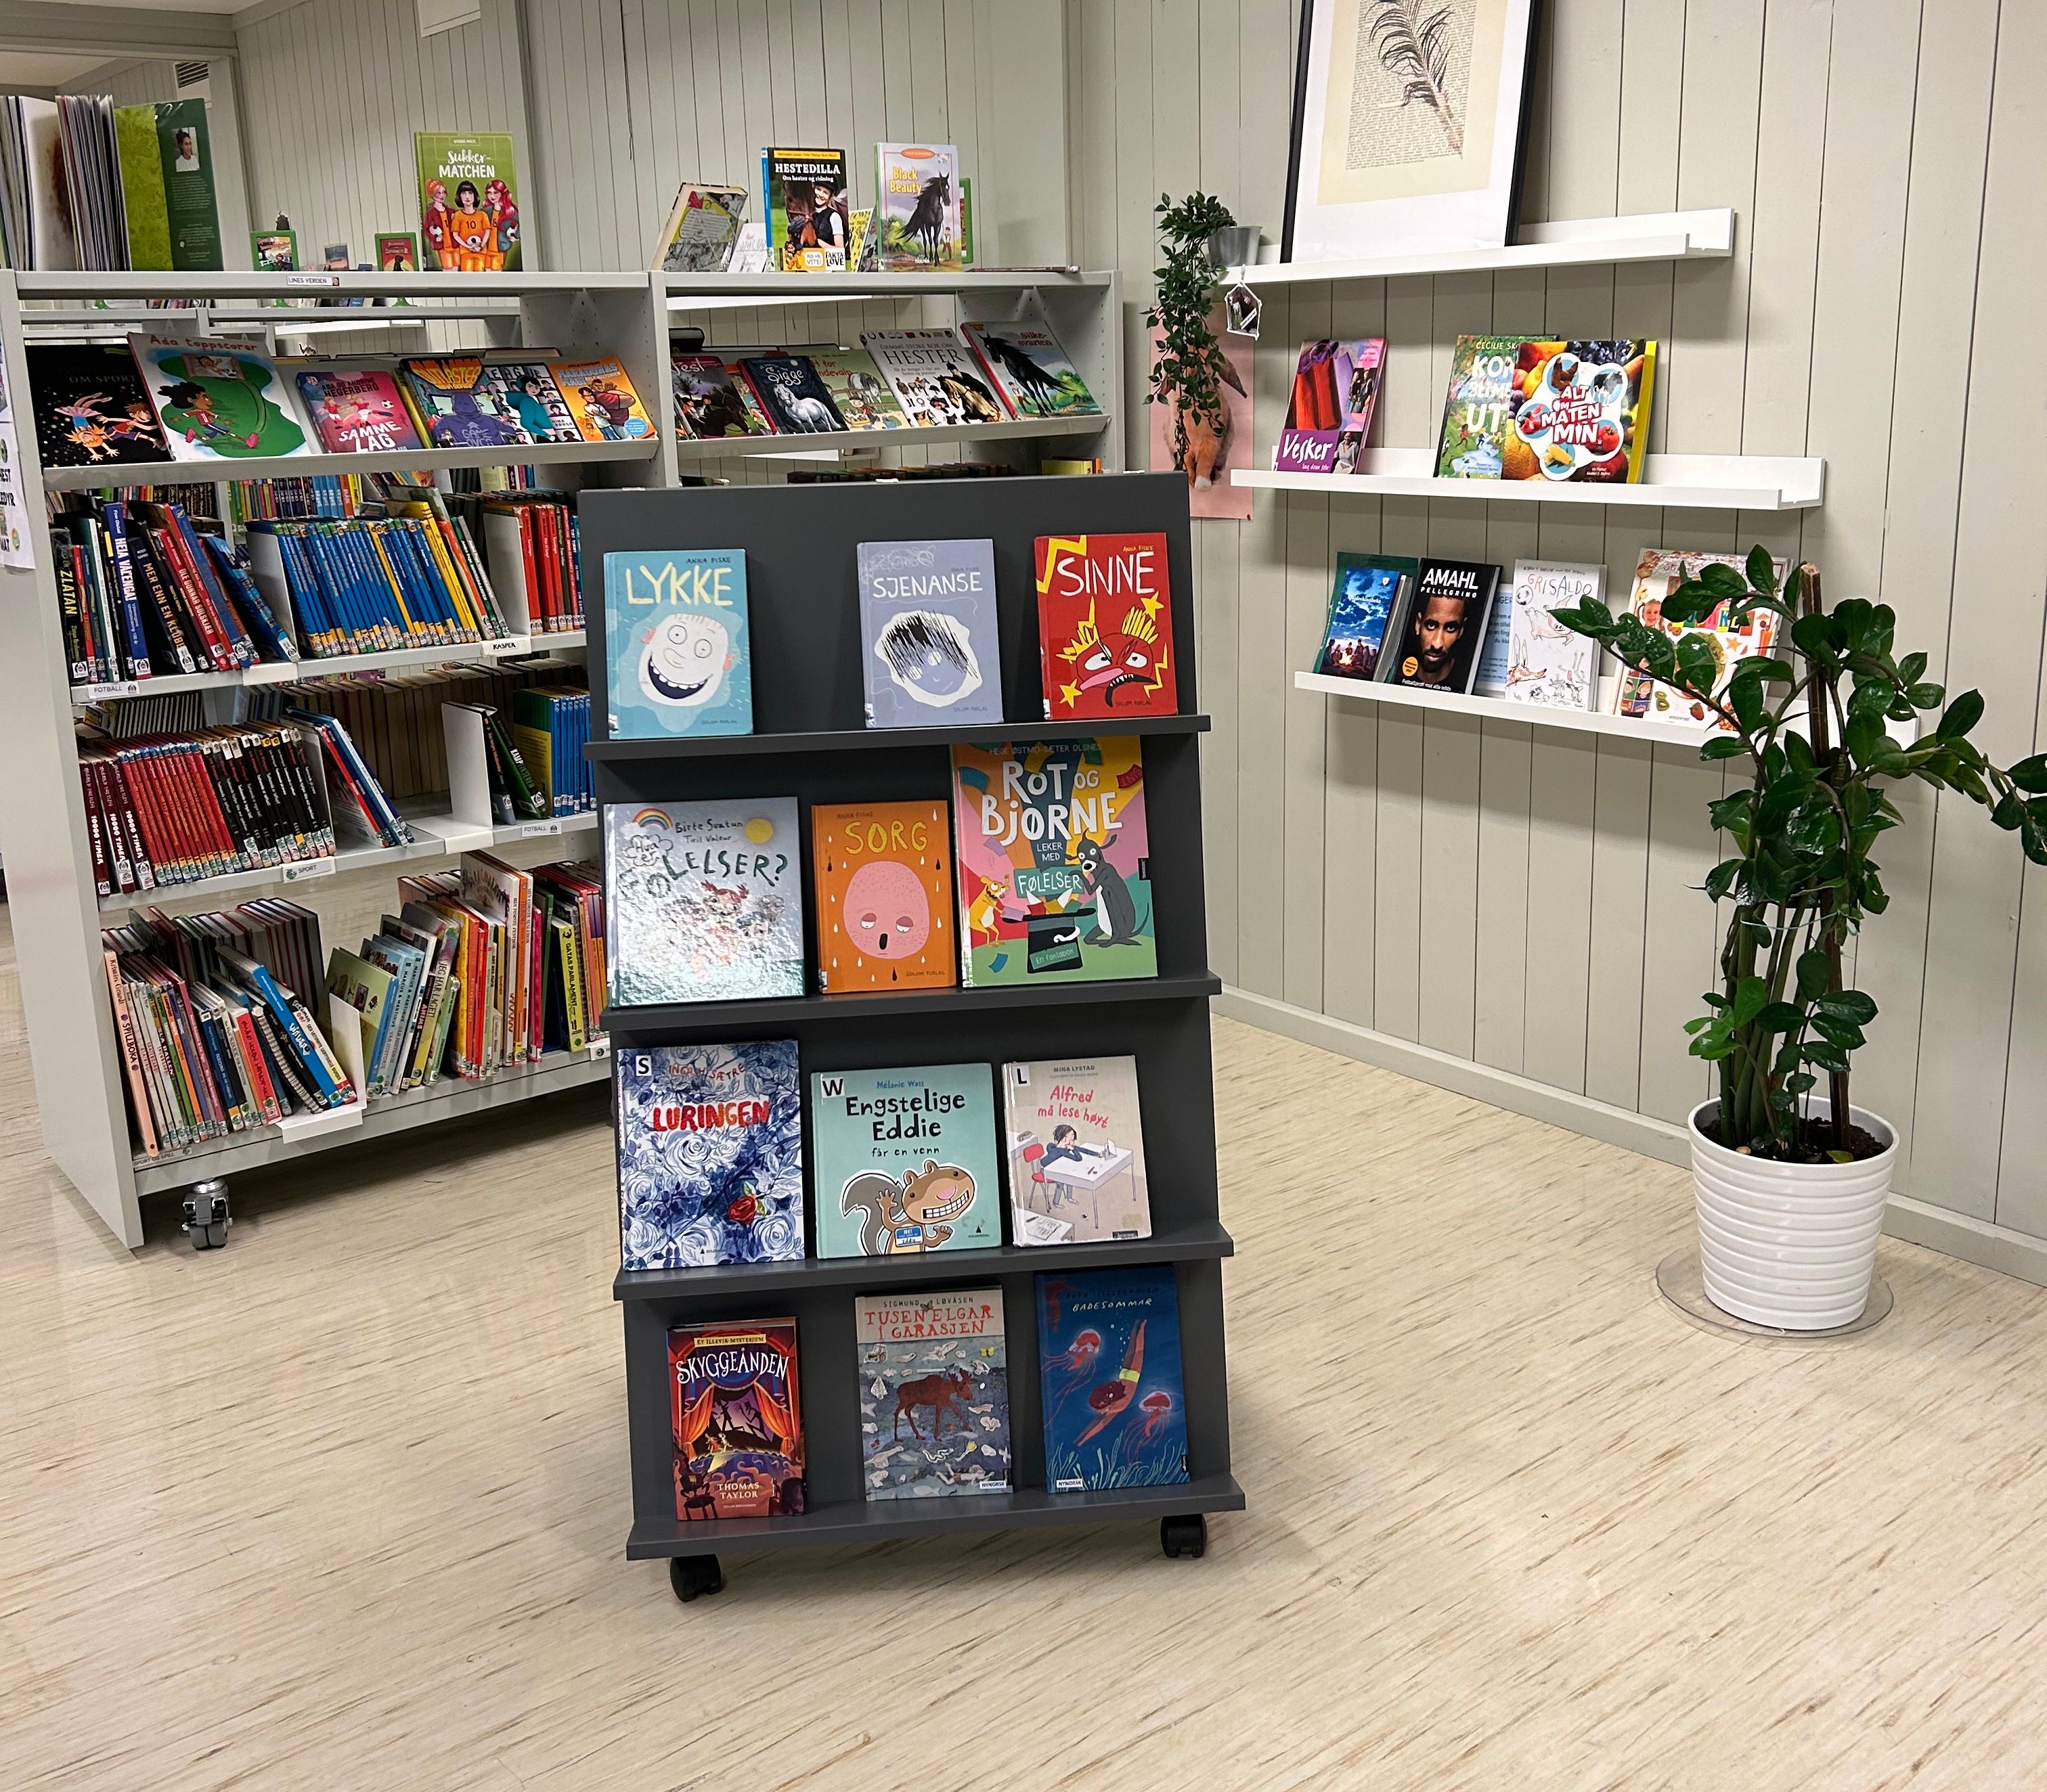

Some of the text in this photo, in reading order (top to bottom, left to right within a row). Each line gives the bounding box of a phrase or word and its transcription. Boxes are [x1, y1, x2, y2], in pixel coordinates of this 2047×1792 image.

[439, 164, 495, 179] MATCHEN
[775, 162, 840, 174] HESTEDILLA
[893, 166, 918, 180] Black
[889, 180, 922, 195] Beauty
[150, 334, 179, 346] Ada
[1476, 340, 1504, 350] CECILIE
[882, 349, 966, 364] HESTER
[766, 366, 805, 386] Sigge
[324, 384, 380, 397] HEGERBERG
[1560, 384, 1590, 401] ALT
[1541, 402, 1600, 428] MATEN
[338, 420, 402, 442] SAMME
[355, 432, 396, 453] LAG
[1282, 433, 1334, 464] Vesker
[114, 537, 129, 560] HEIA
[178, 567, 188, 580] OLE
[1057, 551, 1155, 597] SINNE
[1422, 568, 1478, 590] AMAHL
[60, 569, 78, 616] ZLATAN
[143, 562, 158, 585] MER
[152, 583, 167, 605] ENN
[160, 604, 173, 619] EN
[625, 561, 734, 606] LYKKE
[873, 572, 984, 599] SJENANSE
[1420, 586, 1477, 598] PELLEGRINO
[1528, 574, 1592, 599] GRISALDO
[1074, 769, 1099, 790] OG
[524, 825, 547, 833] FOTBALL
[844, 819, 927, 855] SORG
[1036, 841, 1063, 852] LEKER
[1042, 852, 1061, 861] MED
[298, 865, 317, 874] SPORT
[1017, 871, 1082, 895] FØLELSER
[565, 943, 578, 1007] GATAS PARLAMENT
[121, 1022, 138, 1065] SPILLBOKA
[638, 1057, 650, 1074] S
[668, 1062, 746, 1081] INGA SÆTRE
[1017, 1068, 1028, 1084] L
[822, 1078, 843, 1096] W
[1050, 1085, 1094, 1102] Alfred
[845, 1088, 965, 1117] Engstelige
[653, 1100, 770, 1132] LURINGEN
[1038, 1103, 1109, 1129] må lese høyt
[872, 1113, 942, 1141] Eddie
[871, 1147, 888, 1157] får
[883, 1299, 919, 1307] SIGMUND
[1072, 1298, 1152, 1312] BADESOMMAR
[864, 1304, 994, 1326] TUSEN ELGAR
[891, 1320, 985, 1339] GARASJEN
[676, 1347, 789, 1384] SKYGGEÅNDEN
[717, 1481, 760, 1492] THOMAS
[720, 1490, 758, 1500] TAYLOR
